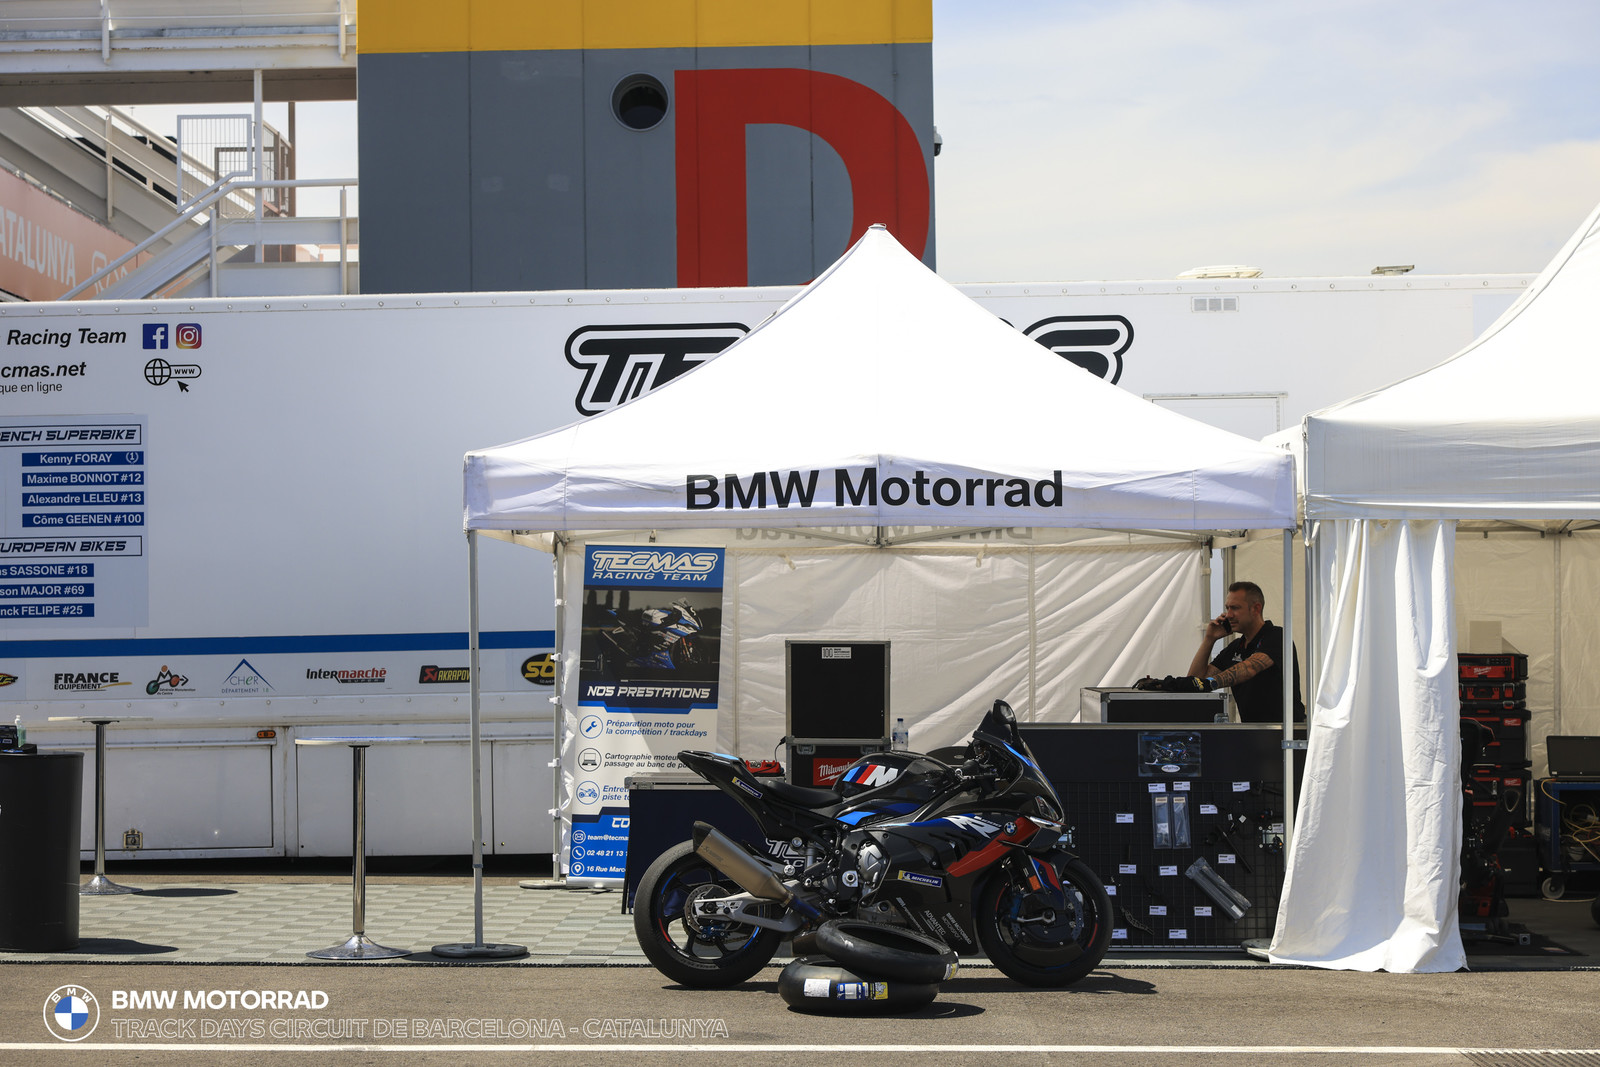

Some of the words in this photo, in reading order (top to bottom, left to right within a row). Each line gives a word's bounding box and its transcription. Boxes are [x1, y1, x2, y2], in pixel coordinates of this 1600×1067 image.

[674, 68, 930, 288] D
[7, 329, 72, 348] Racing
[78, 328, 126, 344] Team
[1, 362, 86, 378] cmas.net
[20, 384, 34, 392] en
[36, 382, 62, 394] ligne
[0, 430, 42, 442] ENCH
[46, 429, 136, 441] SUPERBIKE
[40, 454, 72, 466] Kenny
[75, 453, 112, 463] FORAY
[27, 474, 68, 484] Maxime
[70, 474, 119, 483] BONNOT
[120, 473, 142, 482] #12
[686, 470, 819, 510] BMW
[835, 468, 1063, 508] Motorrad
[28, 494, 80, 504] Alexandre
[83, 494, 118, 503] LELEU
[121, 493, 142, 502] #13
[32, 515, 64, 524] Côme
[66, 514, 112, 524] GEENEN
[114, 514, 142, 523] #100
[0, 542, 76, 552] UROPEAN
[80, 541, 126, 551] BIKES
[592, 551, 718, 573] TECMAS
[10, 566, 65, 575] SASSONE
[67, 565, 88, 575] #18
[21, 586, 62, 595] MAJOR
[64, 586, 84, 595] #69
[0, 606, 19, 616] nck
[22, 606, 60, 615] FELIPE
[62, 606, 83, 615] #25
[54, 672, 119, 683] FRANCE
[587, 686, 615, 697] NOS
[617, 686, 710, 698] PRESTATIONS
[606, 720, 652, 728] Préparation
[670, 729, 707, 737] trackdays
[605, 753, 652, 761] Cartographie
[602, 793, 621, 801] piste
[911, 876, 939, 884] MICHELIN
